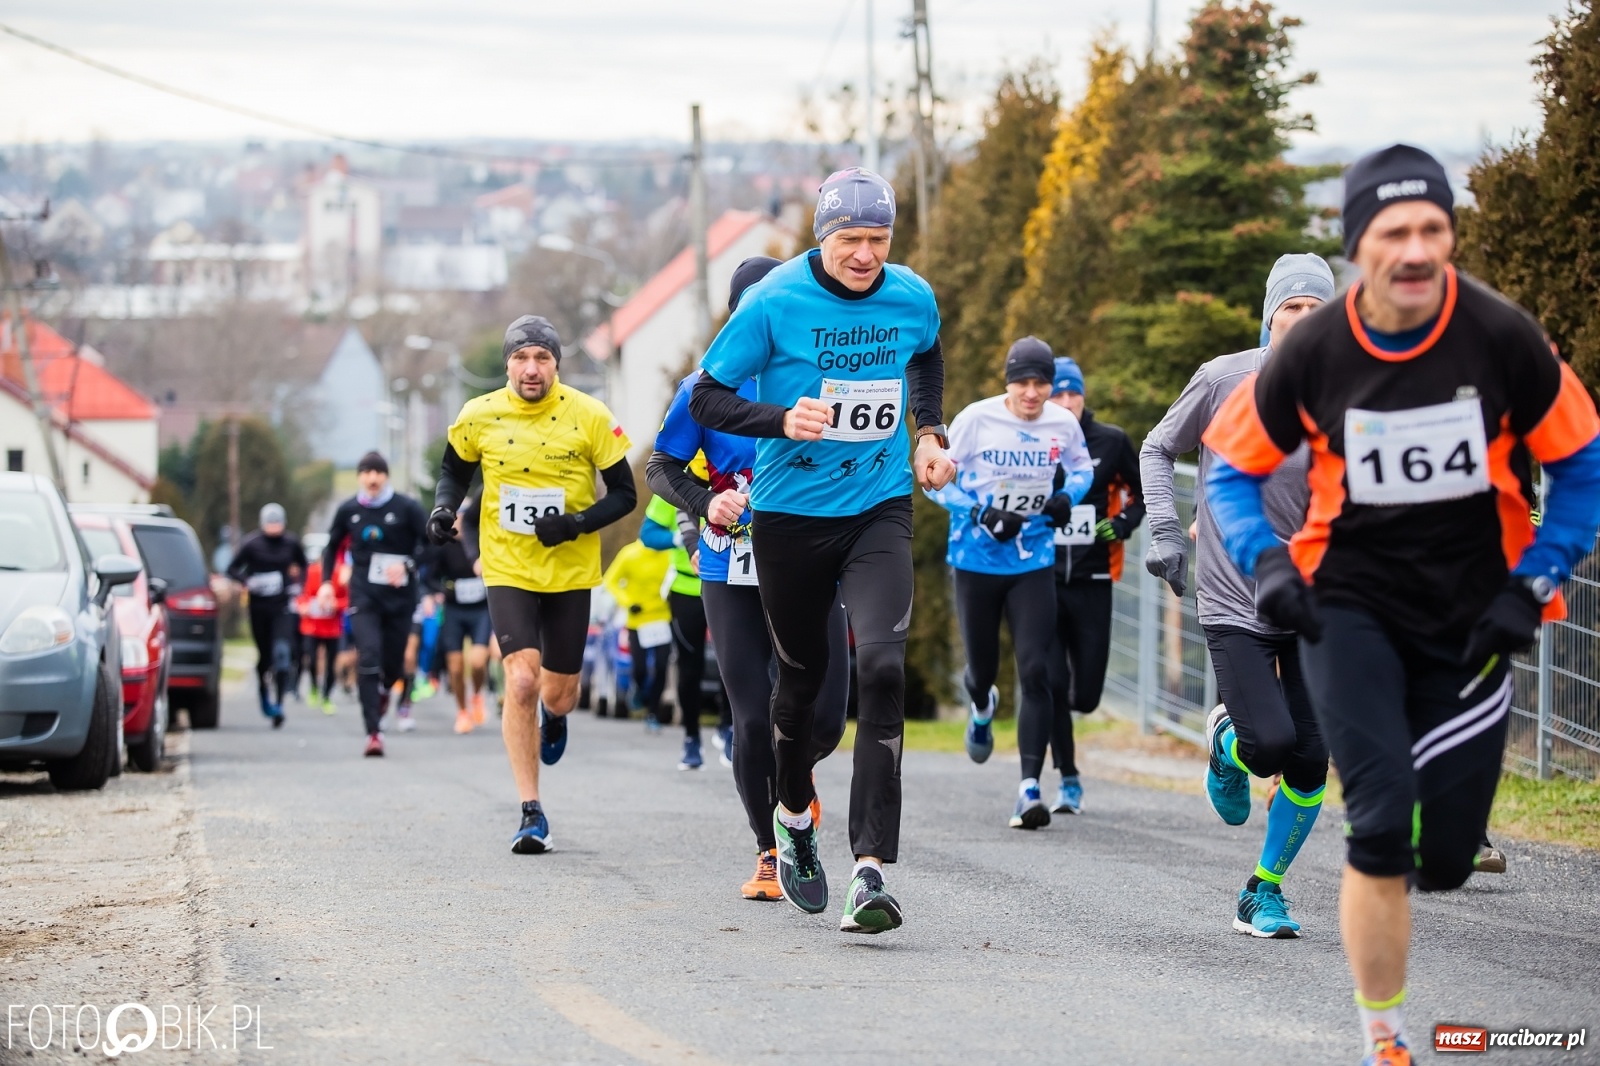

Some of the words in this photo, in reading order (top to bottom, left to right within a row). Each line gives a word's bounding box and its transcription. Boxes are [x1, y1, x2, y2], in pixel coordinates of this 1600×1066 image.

[1290, 281, 1307, 291] 4F
[811, 324, 899, 348] Triathlon
[817, 346, 897, 373] Gogolin
[830, 402, 896, 431] 166
[1360, 439, 1478, 484] 164
[999, 494, 1046, 512] 128
